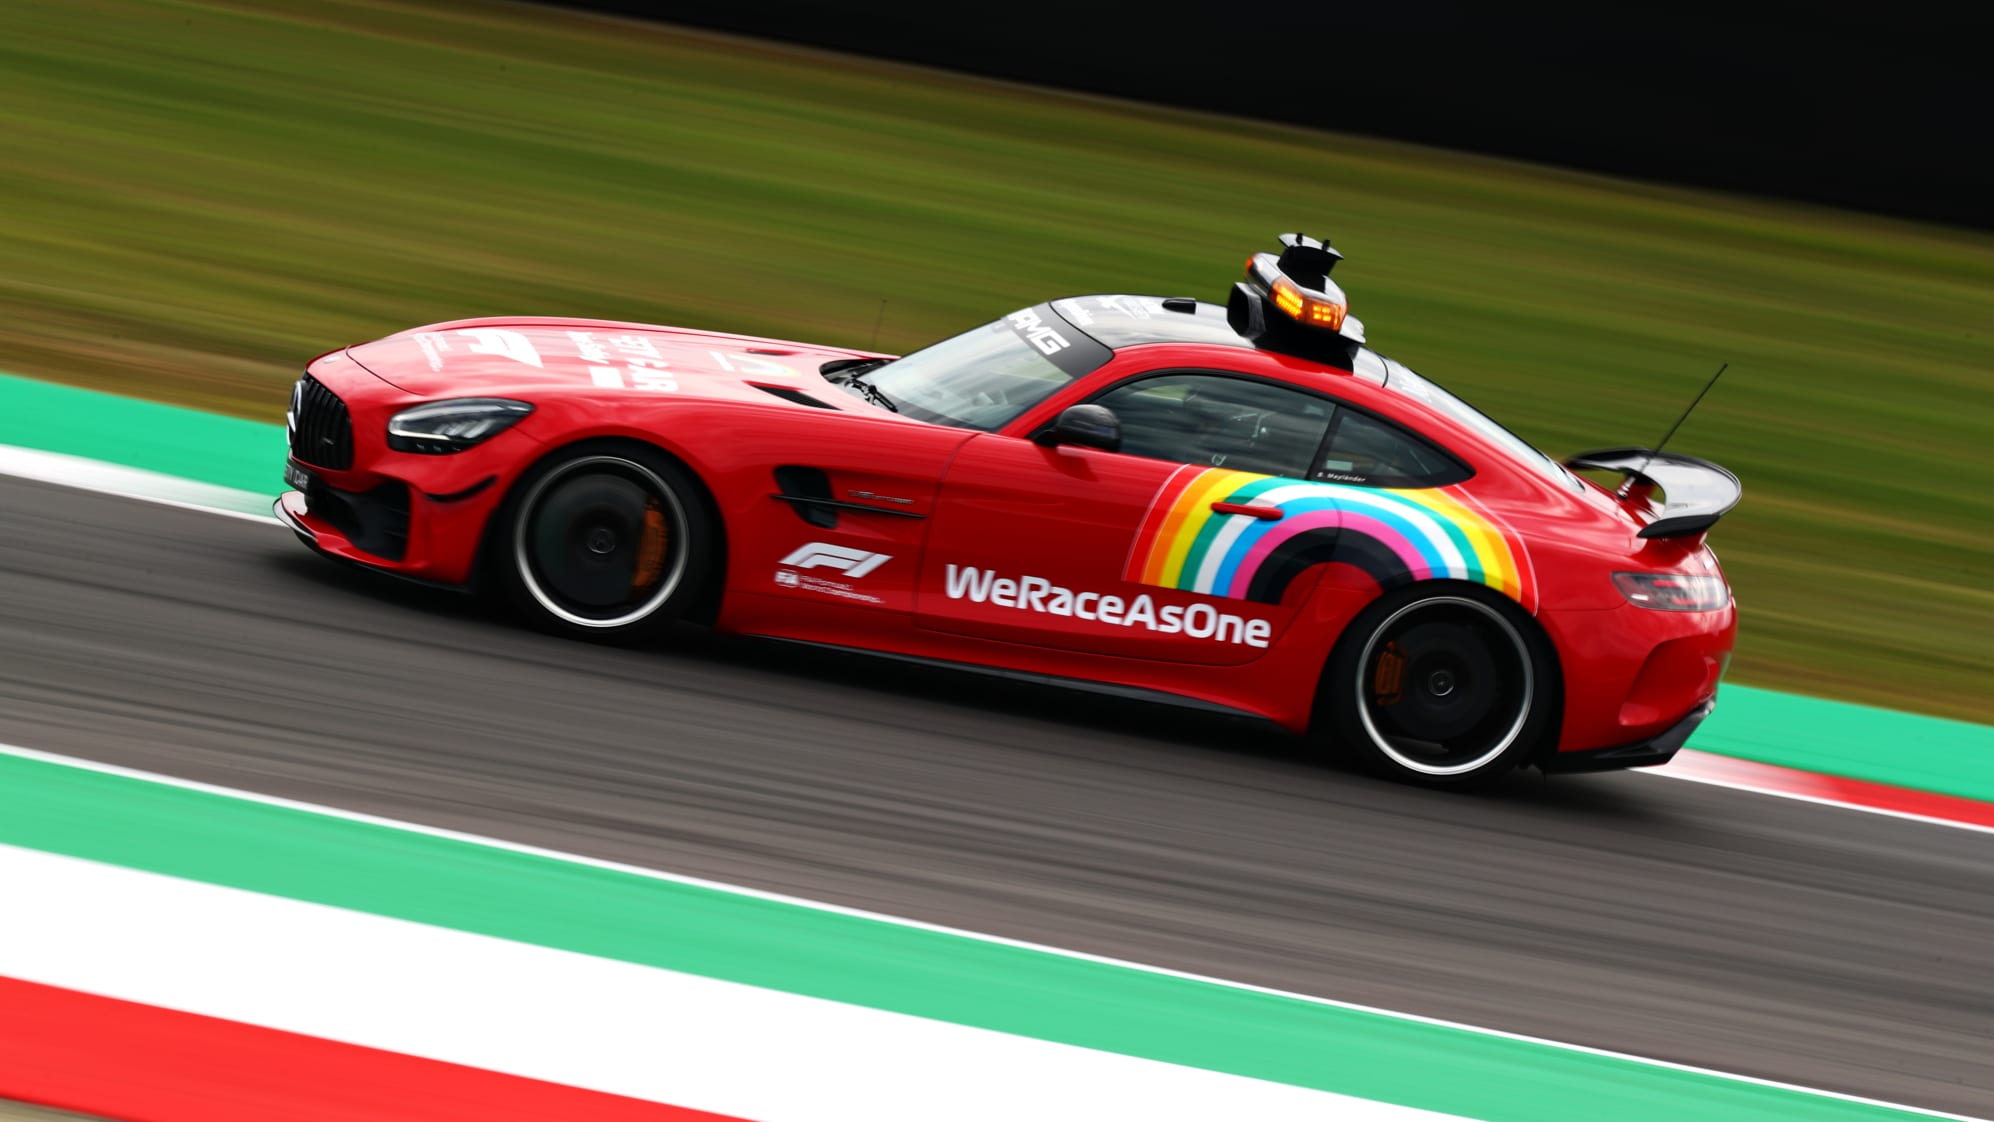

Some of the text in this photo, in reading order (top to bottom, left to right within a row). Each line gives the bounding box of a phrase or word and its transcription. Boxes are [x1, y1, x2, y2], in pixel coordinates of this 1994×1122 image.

[1007, 307, 1071, 355] AMG
[779, 542, 894, 578] F1
[945, 563, 1272, 649] WeRaceAsOne
